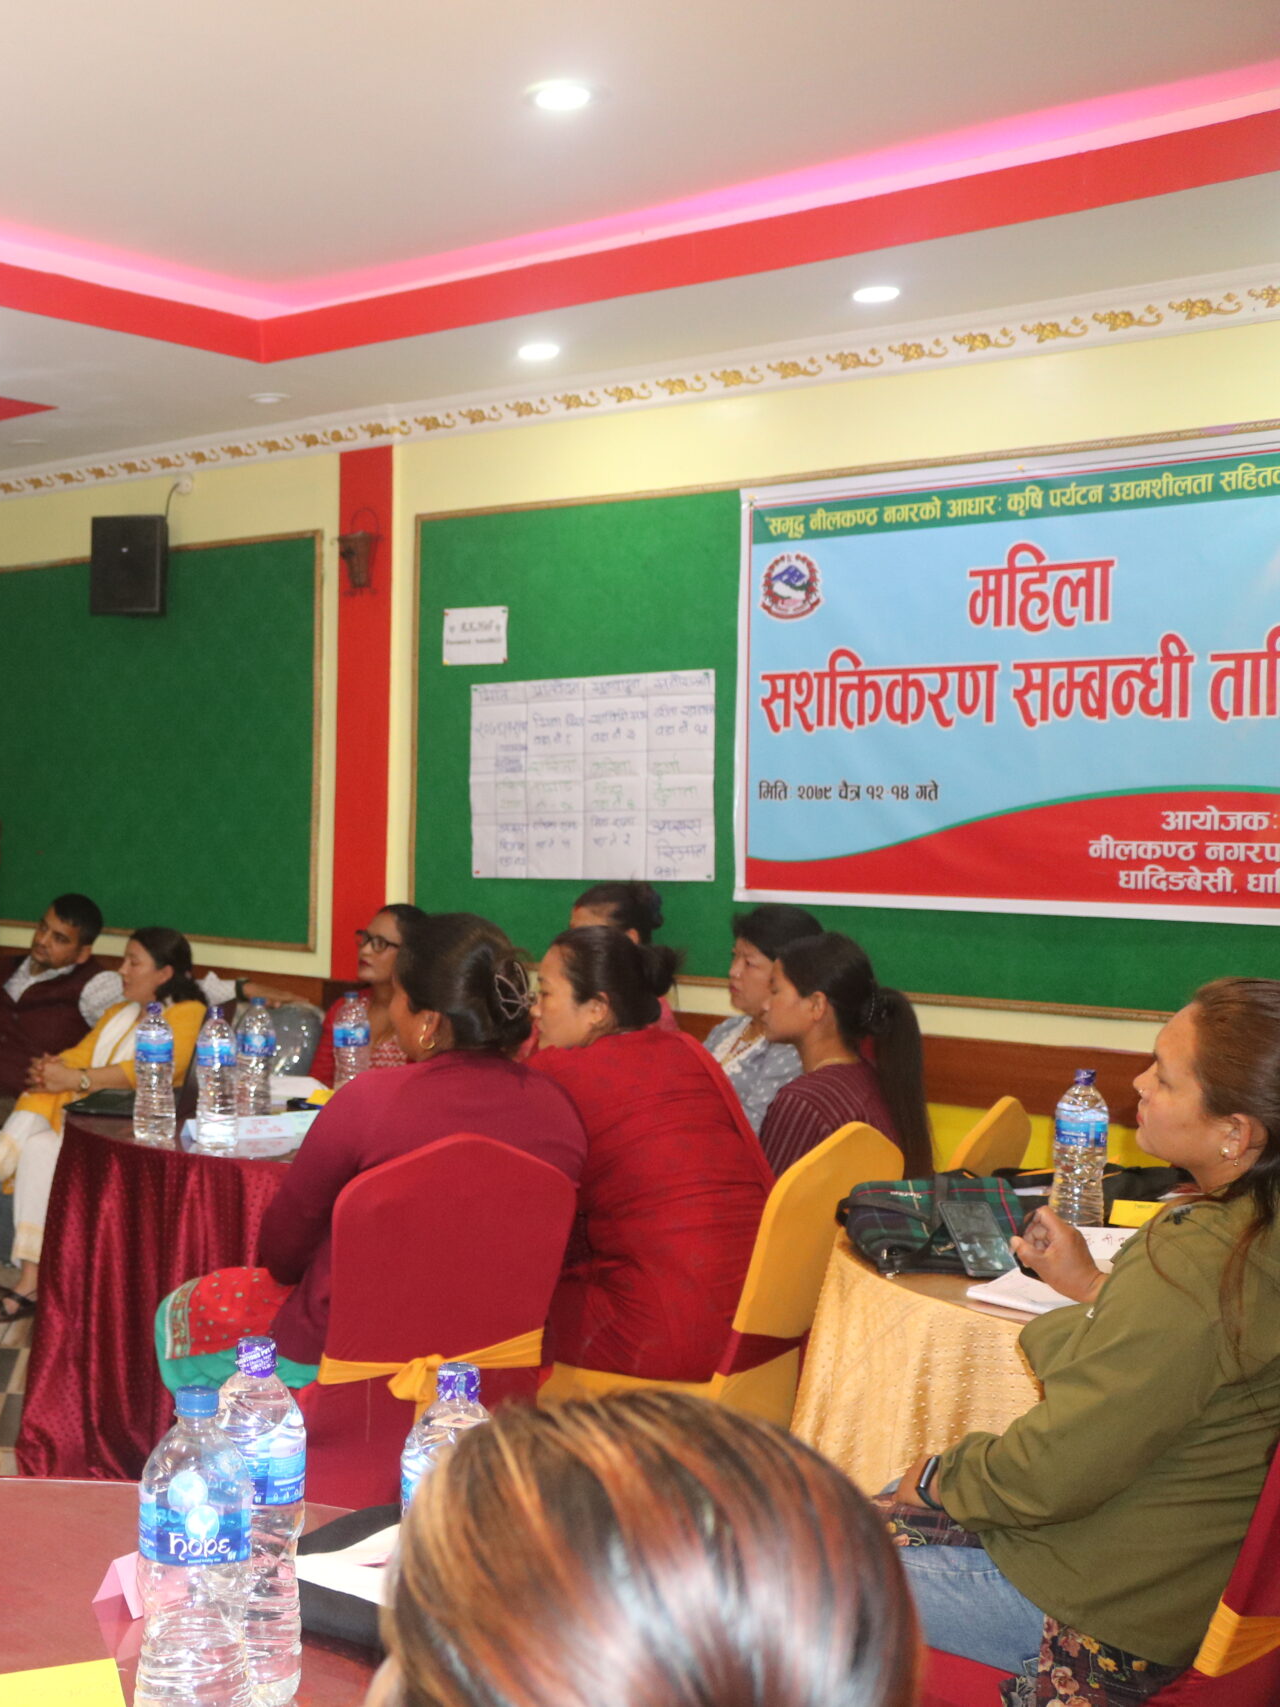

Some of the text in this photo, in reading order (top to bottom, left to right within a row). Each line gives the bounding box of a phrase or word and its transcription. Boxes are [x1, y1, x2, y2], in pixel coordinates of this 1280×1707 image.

[810, 508, 879, 531] नीलकण्ठ
[884, 496, 941, 524] नगरको
[1007, 486, 1043, 516] कृषि
[1049, 482, 1104, 508] पर्यटन
[1109, 472, 1214, 502] उद्यमशीलता
[967, 543, 1116, 632] महिला
[760, 648, 998, 733] सशक्तिकरण
[1012, 633, 1195, 727] सम्बन्धी
[915, 780, 939, 801] गते
[1088, 834, 1198, 861] नीलकण्ठ
